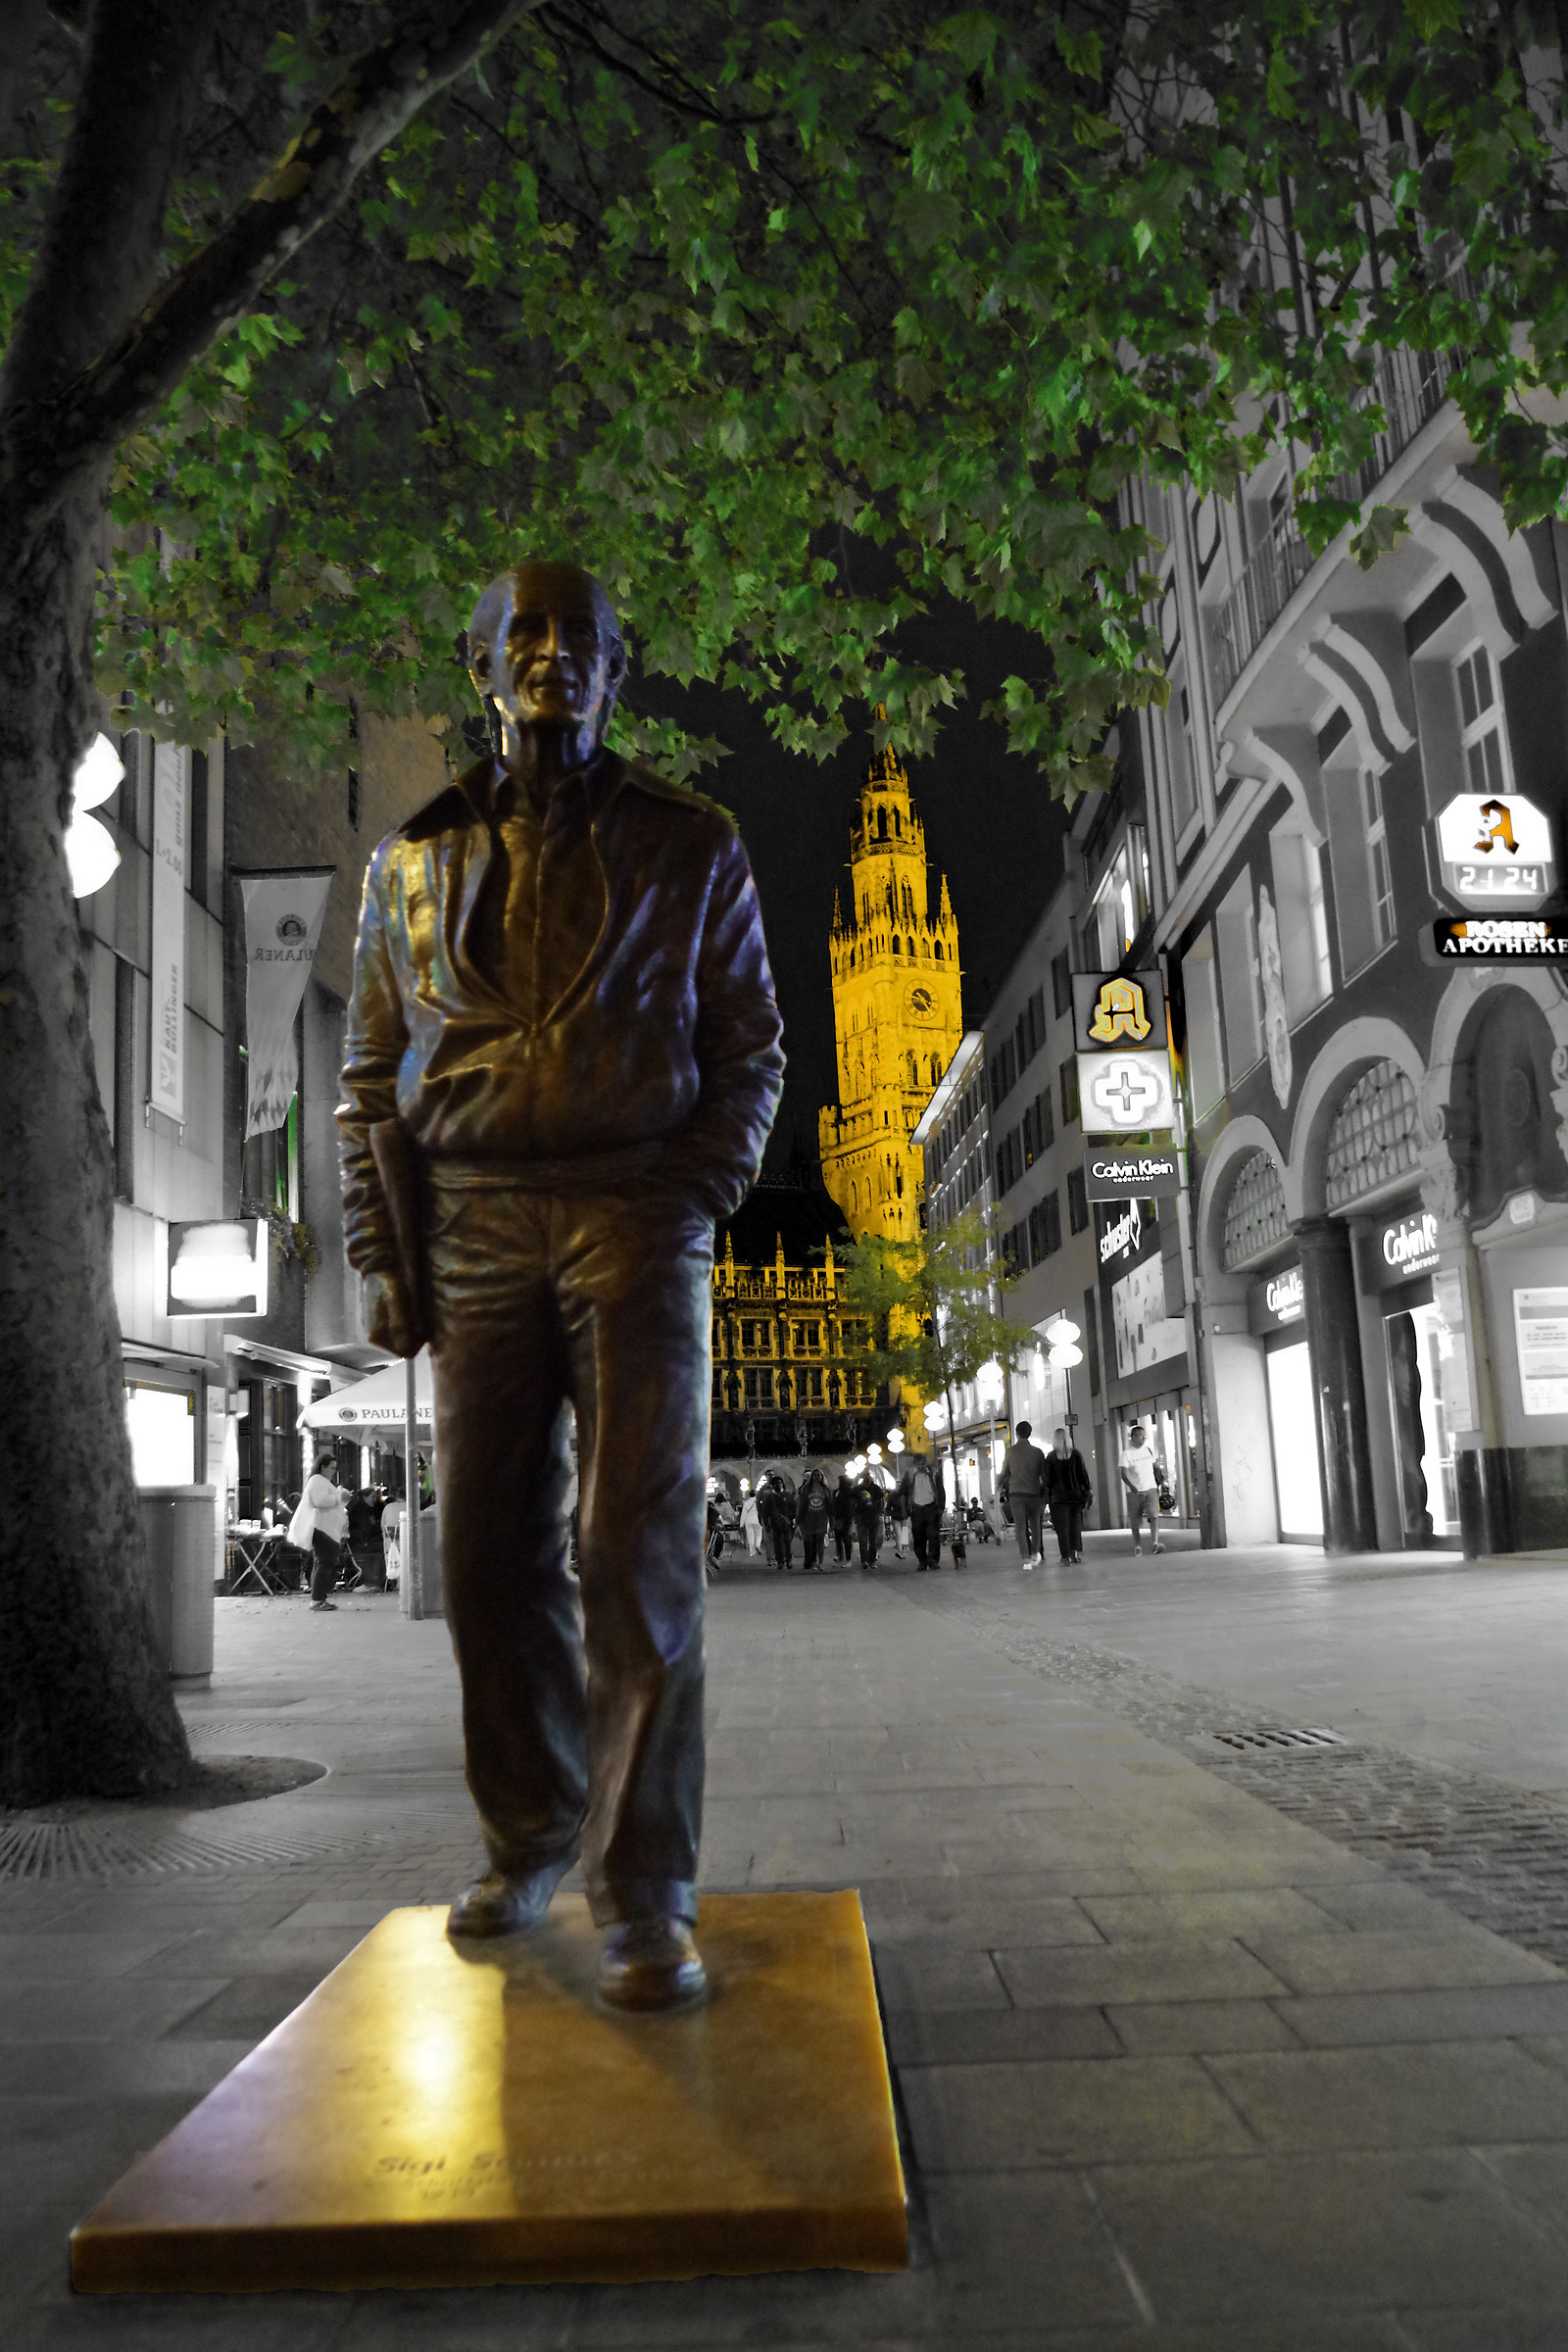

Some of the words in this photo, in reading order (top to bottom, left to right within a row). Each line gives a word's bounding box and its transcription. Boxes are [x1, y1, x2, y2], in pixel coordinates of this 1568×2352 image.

[1465, 920, 1546, 939] ROSEN
[1443, 938, 1568, 954] APOTHEKE
[1092, 1160, 1138, 1178] Calvin
[1138, 1158, 1173, 1176] Klein
[1383, 1219, 1425, 1265] Calvin
[1402, 1253, 1440, 1275] underwear
